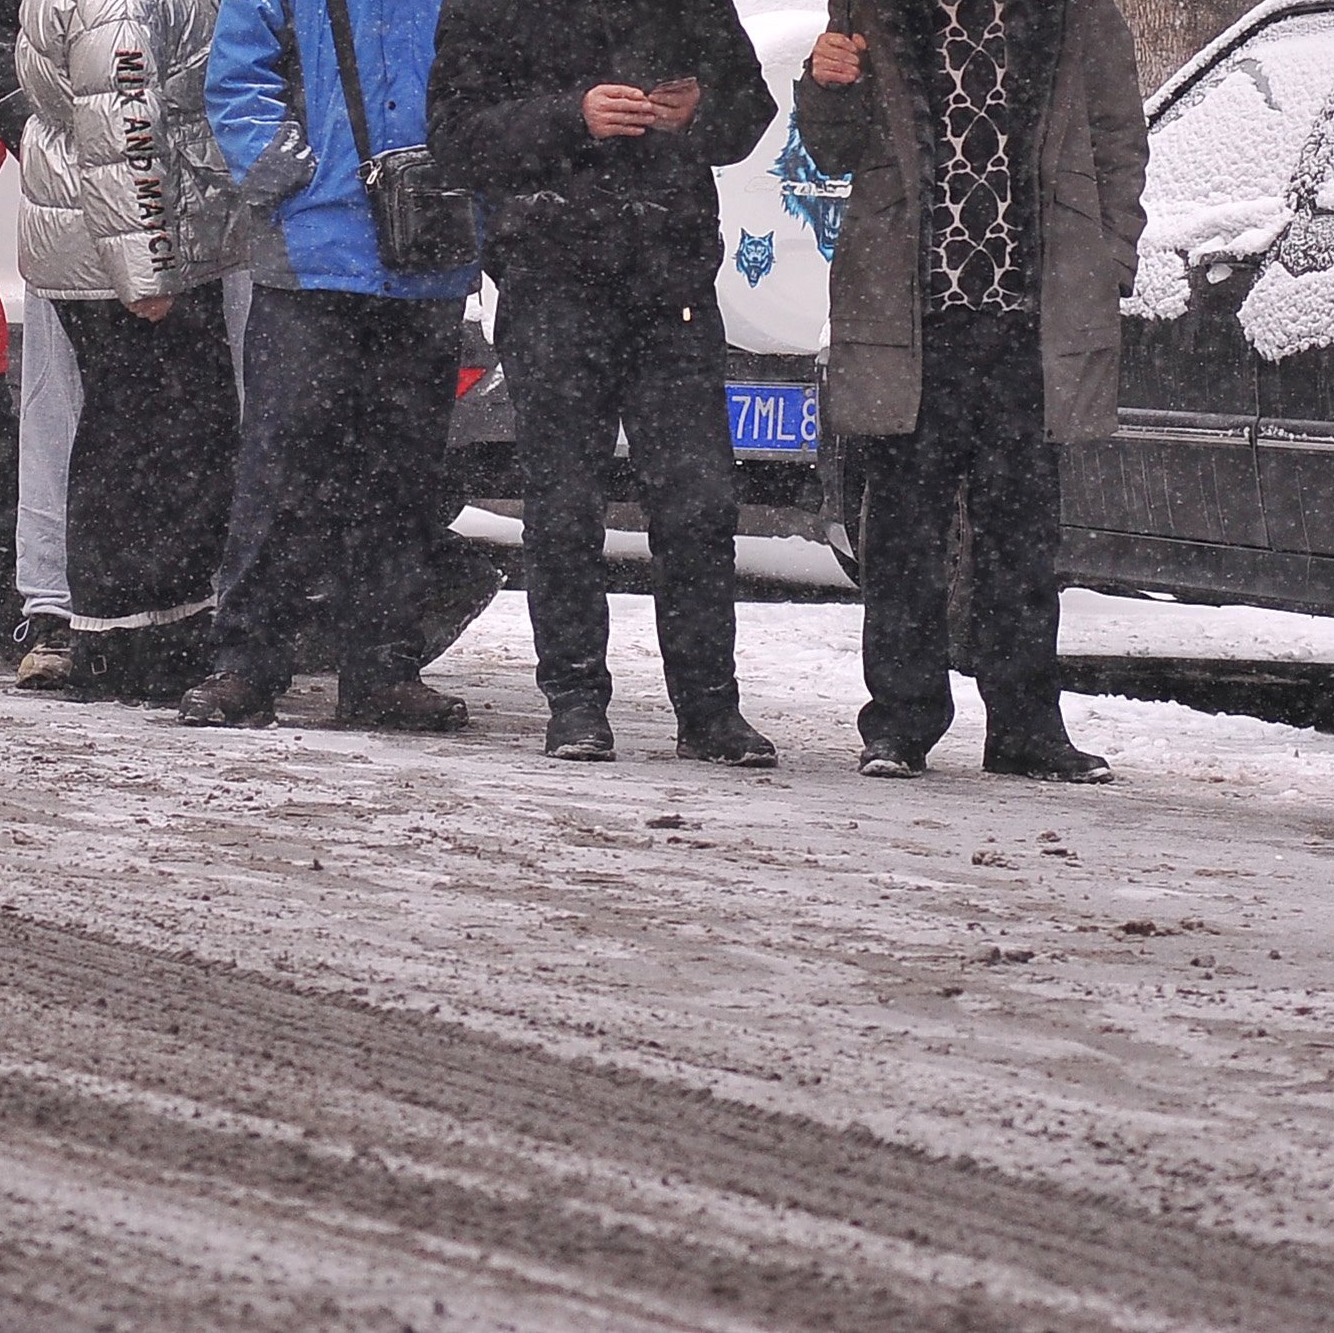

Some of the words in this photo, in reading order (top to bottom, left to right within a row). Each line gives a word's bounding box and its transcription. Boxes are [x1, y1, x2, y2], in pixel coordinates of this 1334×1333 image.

[114, 49, 148, 108] MIX
[122, 116, 155, 173] AND
[731, 395, 817, 441] 7ML8
